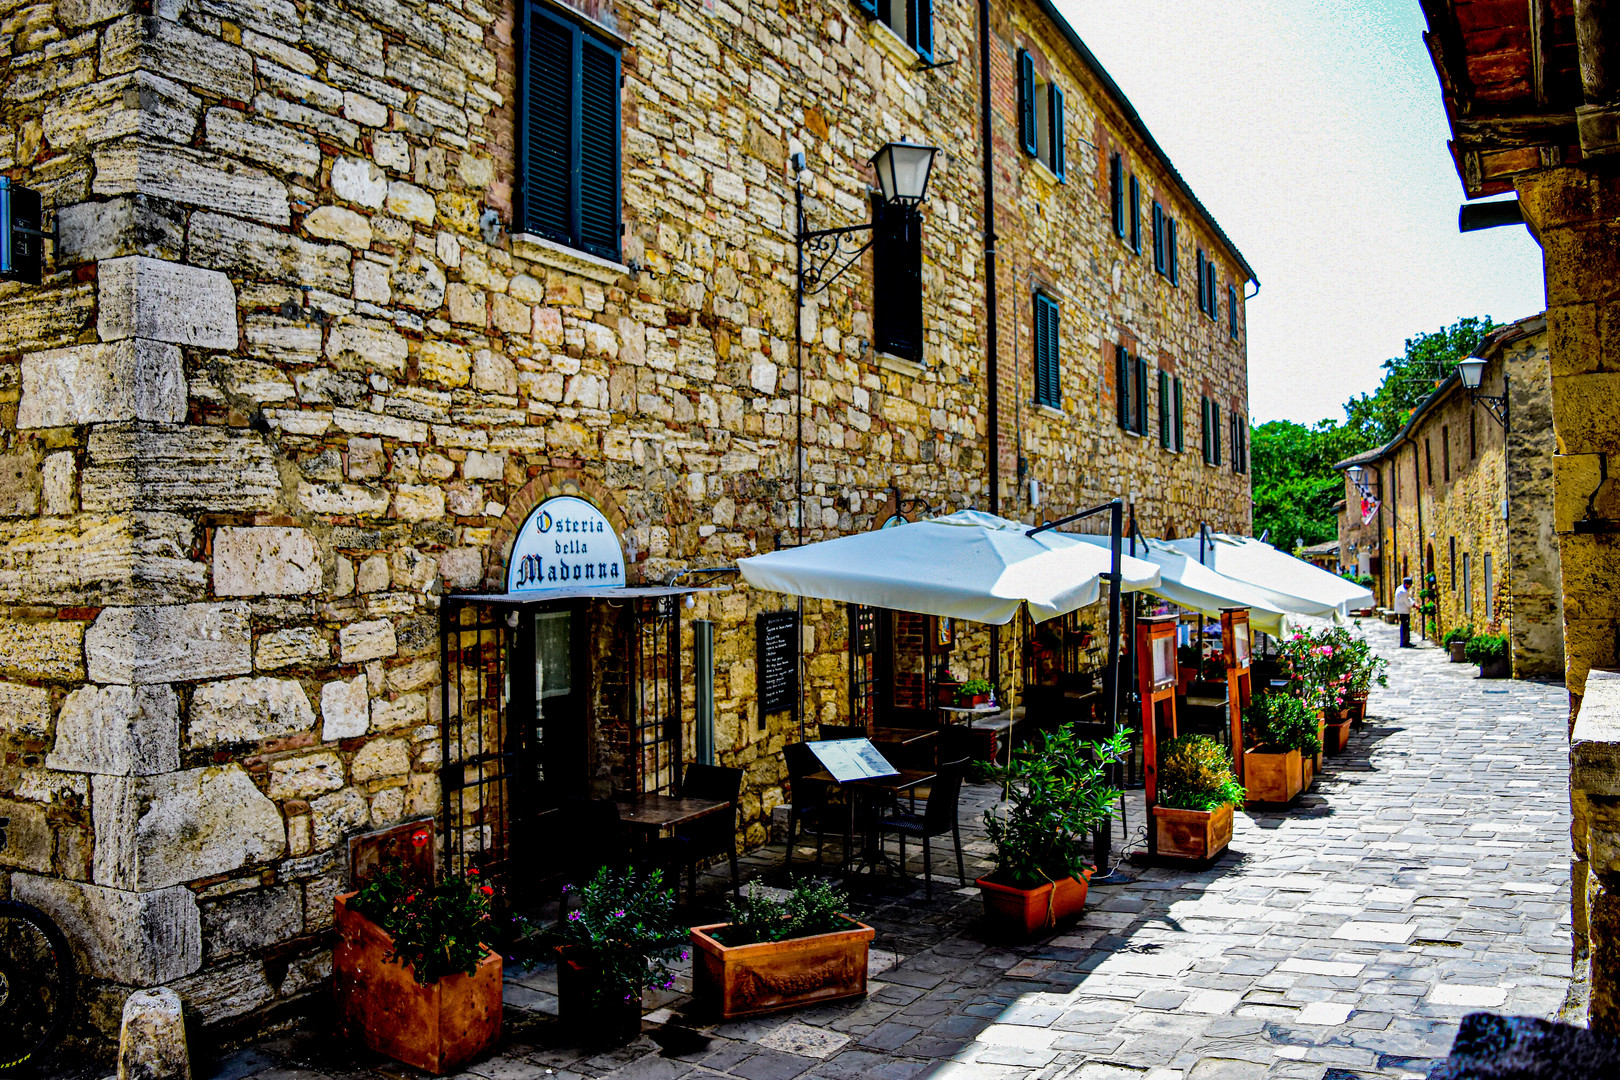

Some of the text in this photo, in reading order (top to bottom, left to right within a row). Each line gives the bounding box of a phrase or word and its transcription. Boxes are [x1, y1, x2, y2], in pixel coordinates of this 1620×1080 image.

[537, 510, 604, 533] Osteria
[555, 540, 588, 554] della
[516, 554, 619, 589] Madonna
